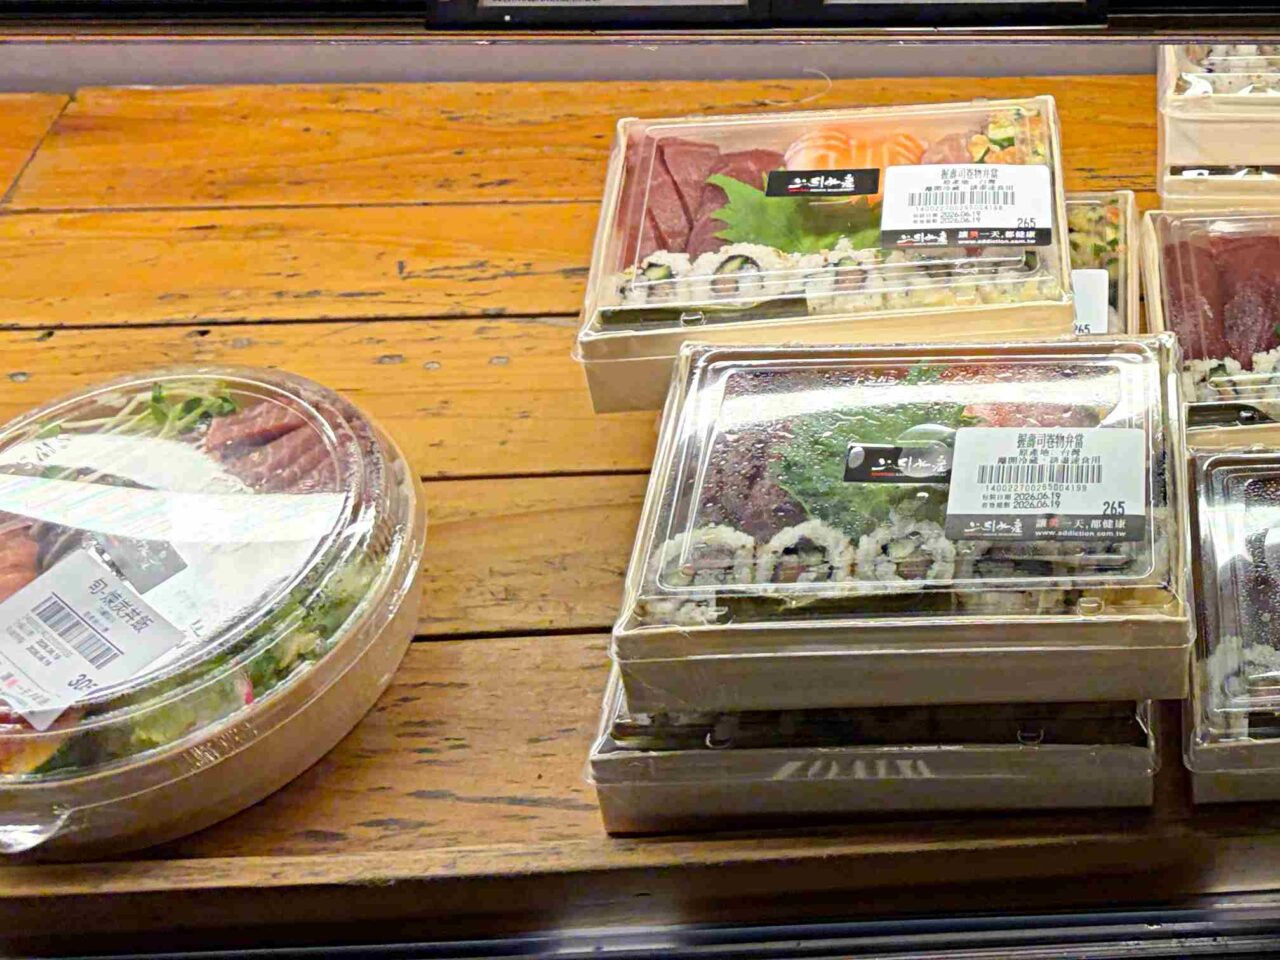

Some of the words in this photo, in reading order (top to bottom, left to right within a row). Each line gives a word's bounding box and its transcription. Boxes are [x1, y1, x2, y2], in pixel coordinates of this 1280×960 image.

[1017, 217, 1036, 229] 265
[1014, 492, 1060, 500] 2026.06.19
[1103, 501, 1125, 516] 265
